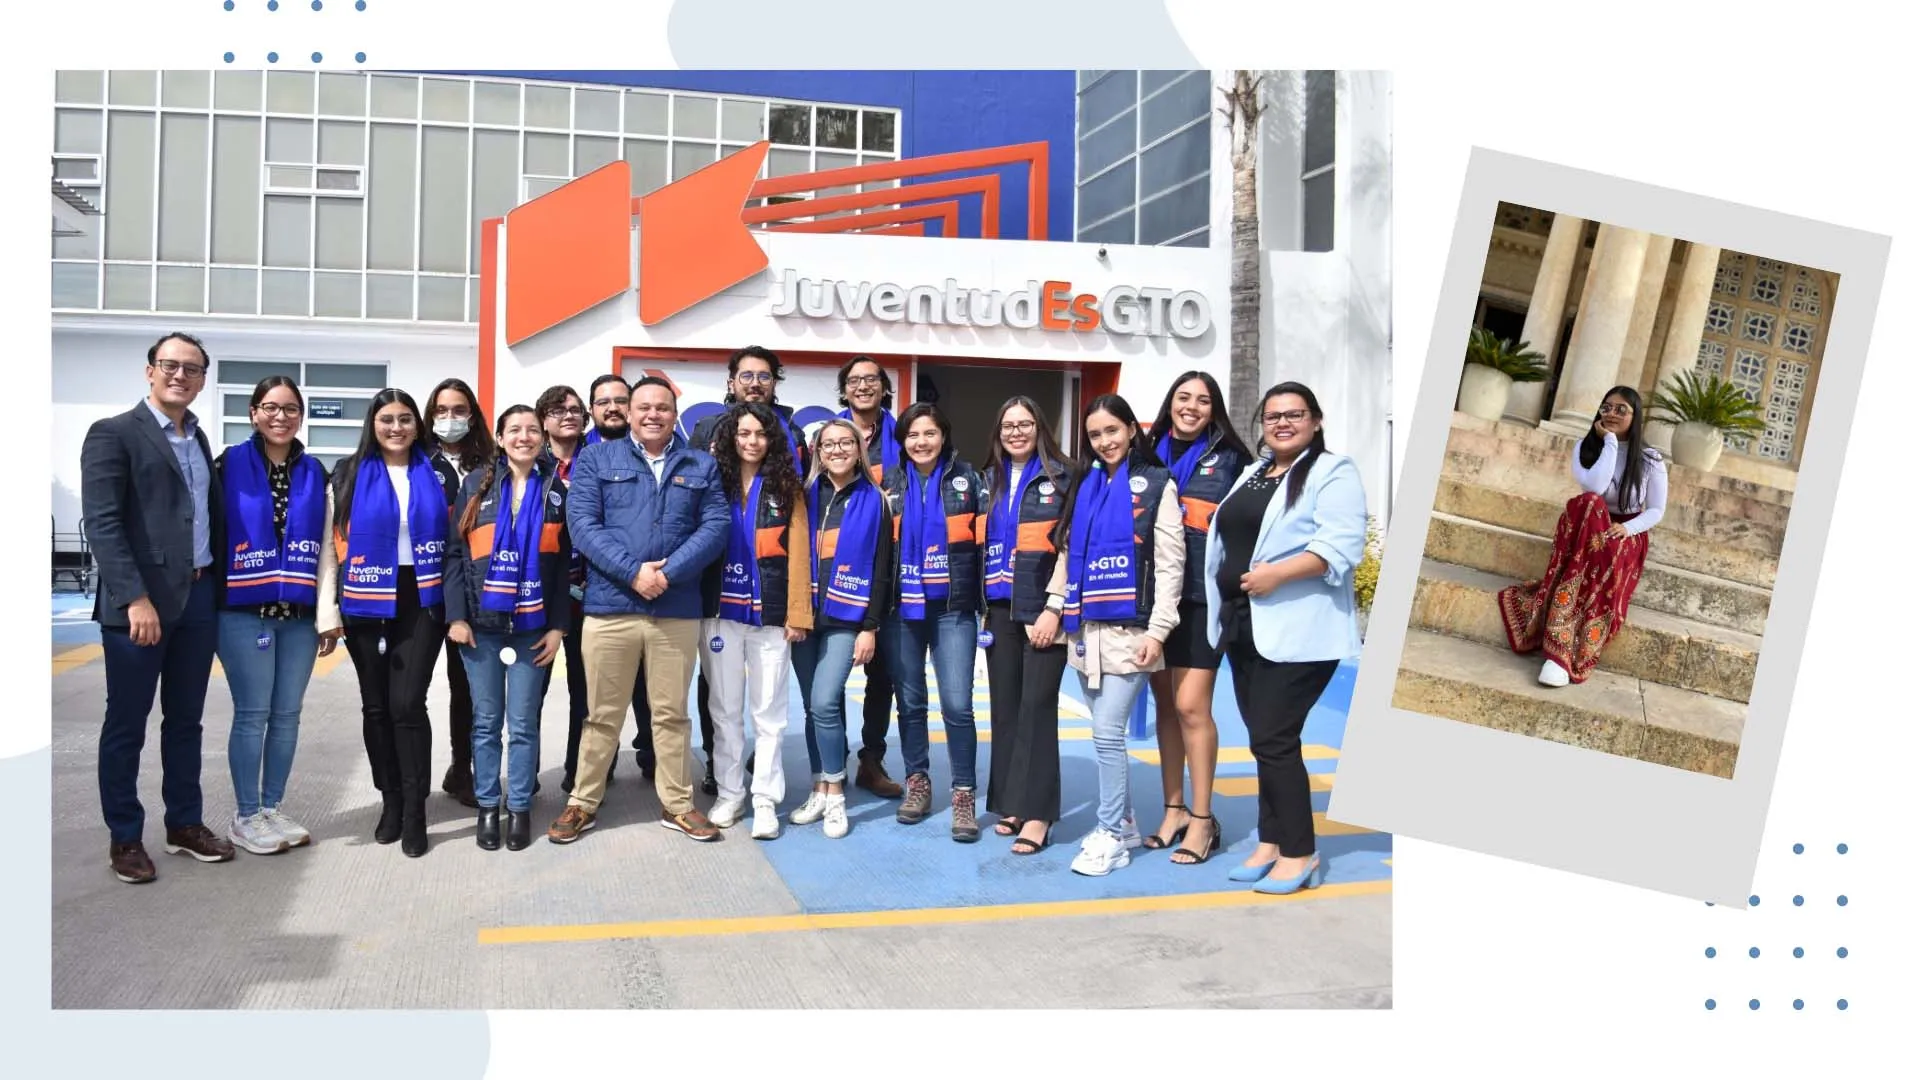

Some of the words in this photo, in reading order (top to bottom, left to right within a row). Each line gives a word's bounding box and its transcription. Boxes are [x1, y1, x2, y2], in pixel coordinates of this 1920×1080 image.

[771, 267, 1212, 339] JuventudEsGTO
[234, 548, 277, 562] Juventud
[349, 564, 393, 576] Juventud
[1104, 571, 1129, 580] mundo
[835, 571, 870, 586] Juventud
